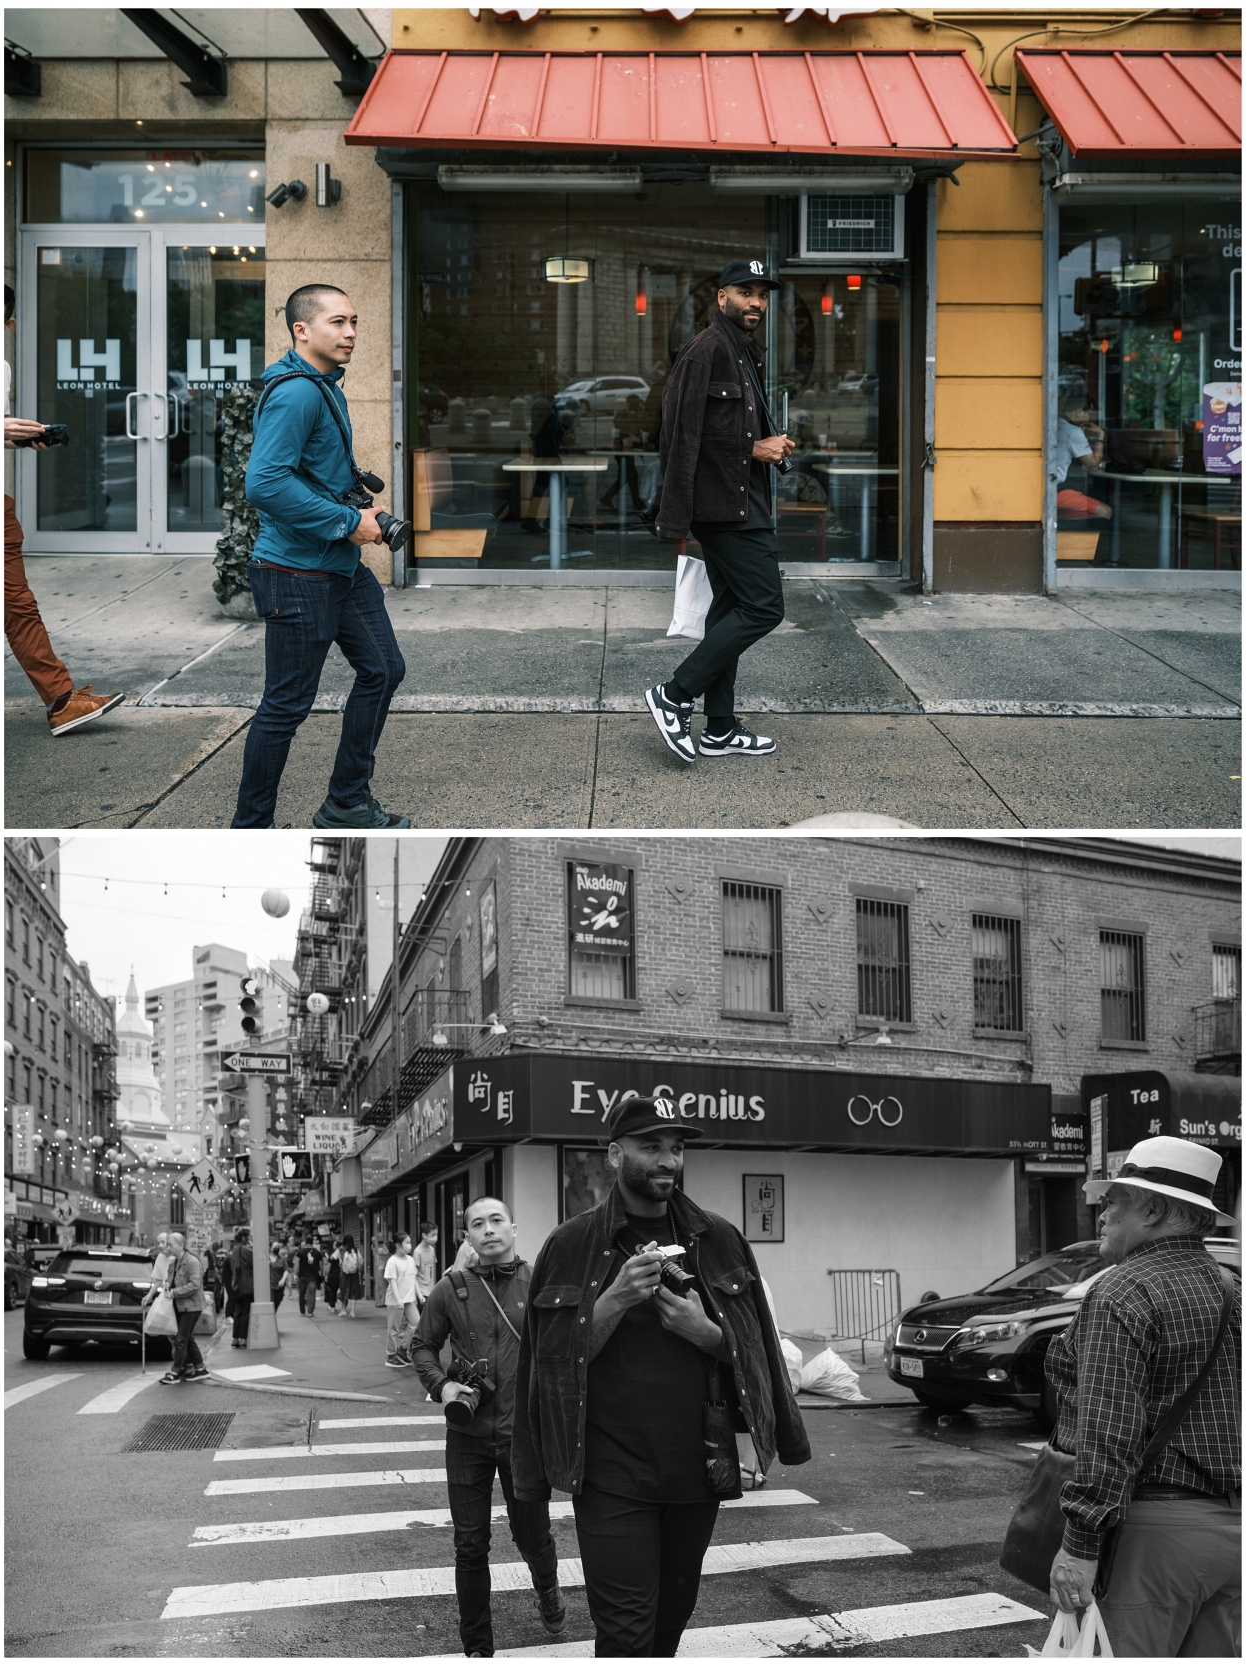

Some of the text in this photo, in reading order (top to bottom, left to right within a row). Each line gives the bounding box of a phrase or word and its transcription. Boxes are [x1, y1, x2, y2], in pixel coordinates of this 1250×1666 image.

[117, 174, 198, 206] 125
[1206, 224, 1242, 240] This
[57, 339, 121, 381] LH
[186, 339, 250, 381] LH
[57, 382, 121, 390] LEON HOTEL
[186, 382, 251, 390] LEON HOTEL
[1207, 433, 1221, 442] for
[577, 873, 628, 896] Akademi
[231, 1057, 282, 1068] ONE WAY
[1130, 1089, 1160, 1105] Tea
[1179, 1118, 1217, 1136] Sun's
[314, 1134, 338, 1142] WINE
[1040, 1141, 1048, 1149] ST.
